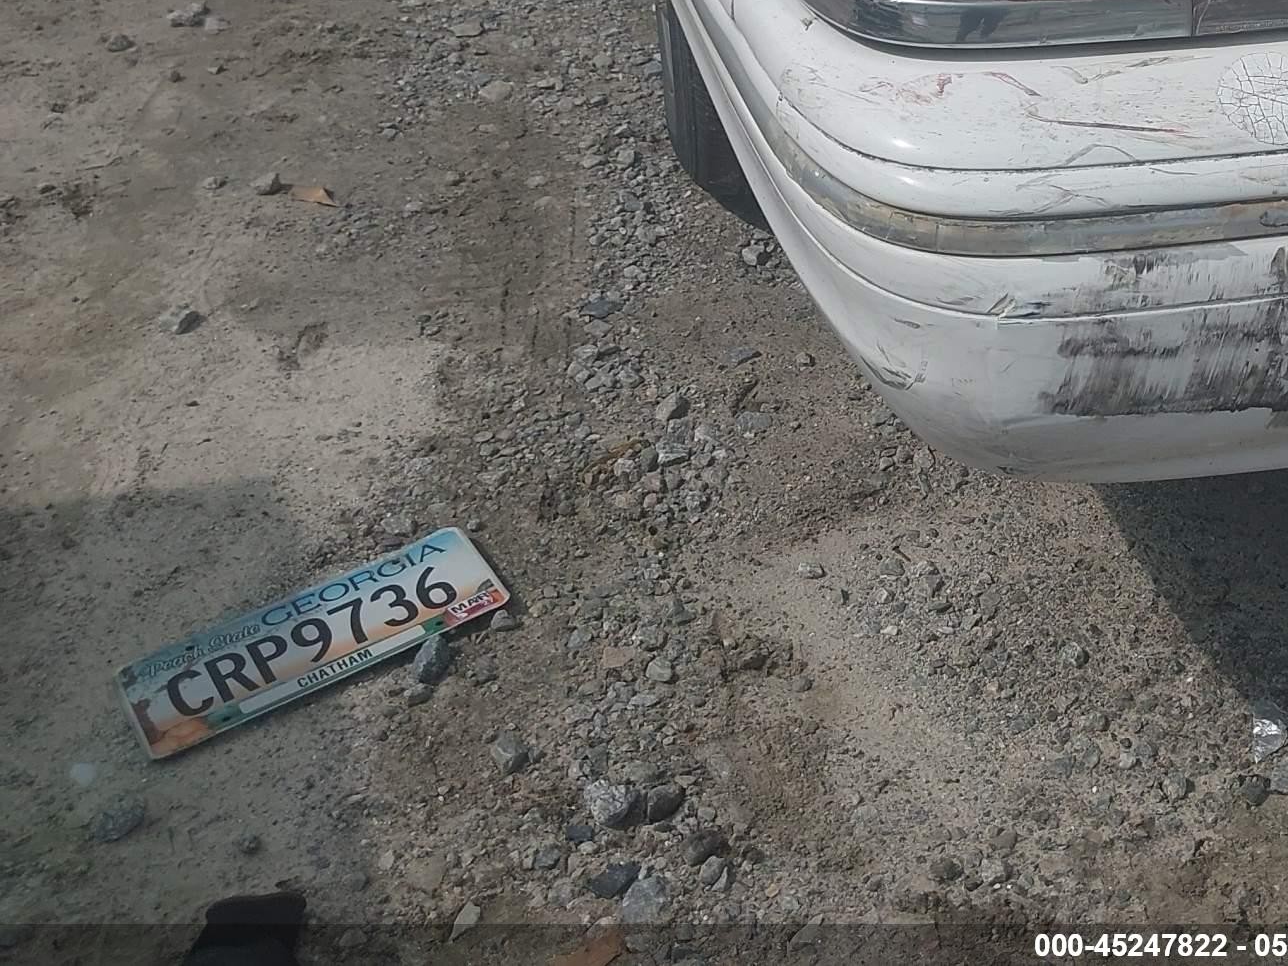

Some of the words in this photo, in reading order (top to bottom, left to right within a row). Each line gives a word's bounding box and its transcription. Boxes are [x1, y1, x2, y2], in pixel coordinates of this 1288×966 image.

[260, 543, 447, 627] GEORGIA
[166, 565, 459, 718] CRP9736
[296, 647, 375, 690] CHATHAM
